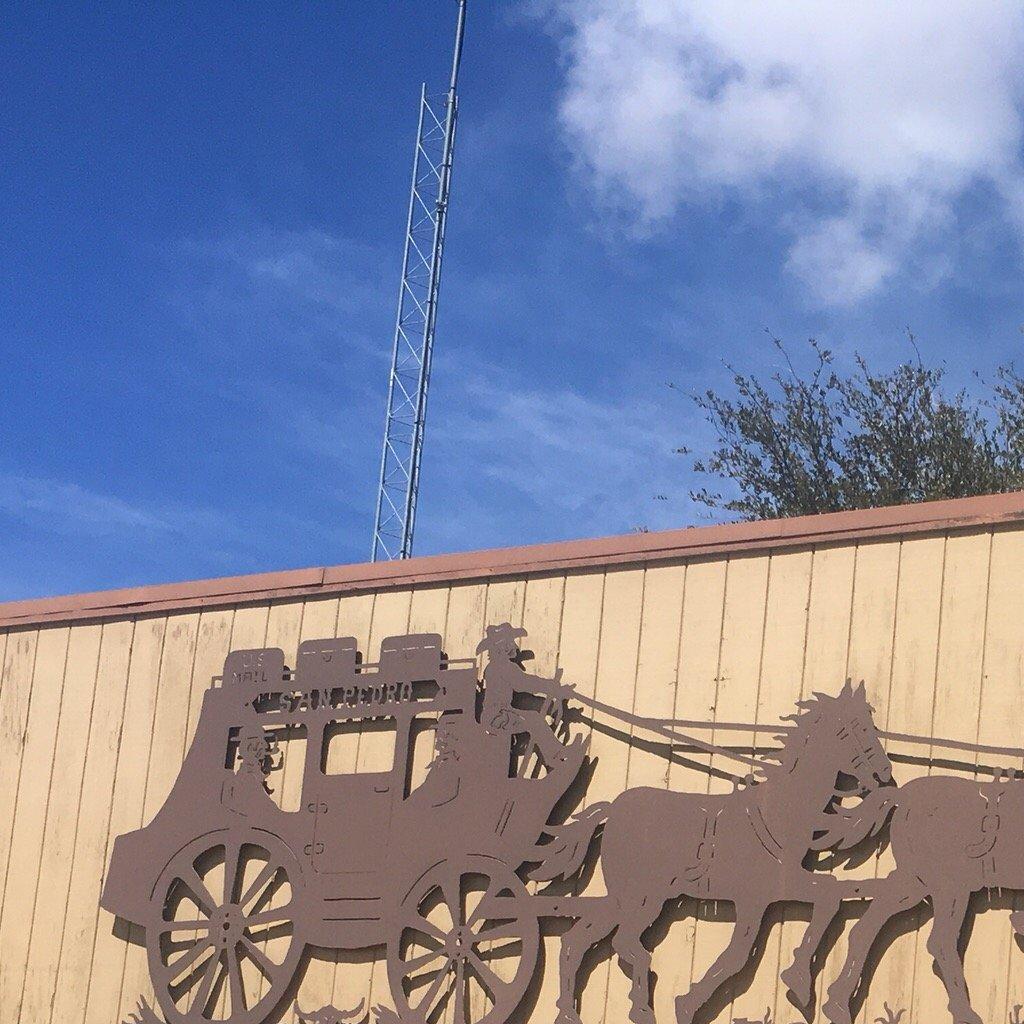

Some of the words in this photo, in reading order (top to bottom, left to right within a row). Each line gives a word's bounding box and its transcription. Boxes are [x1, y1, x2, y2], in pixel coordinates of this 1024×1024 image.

[231, 671, 268, 683] MAIL
[280, 687, 331, 712] SAN
[342, 681, 413, 707] PEDRO
